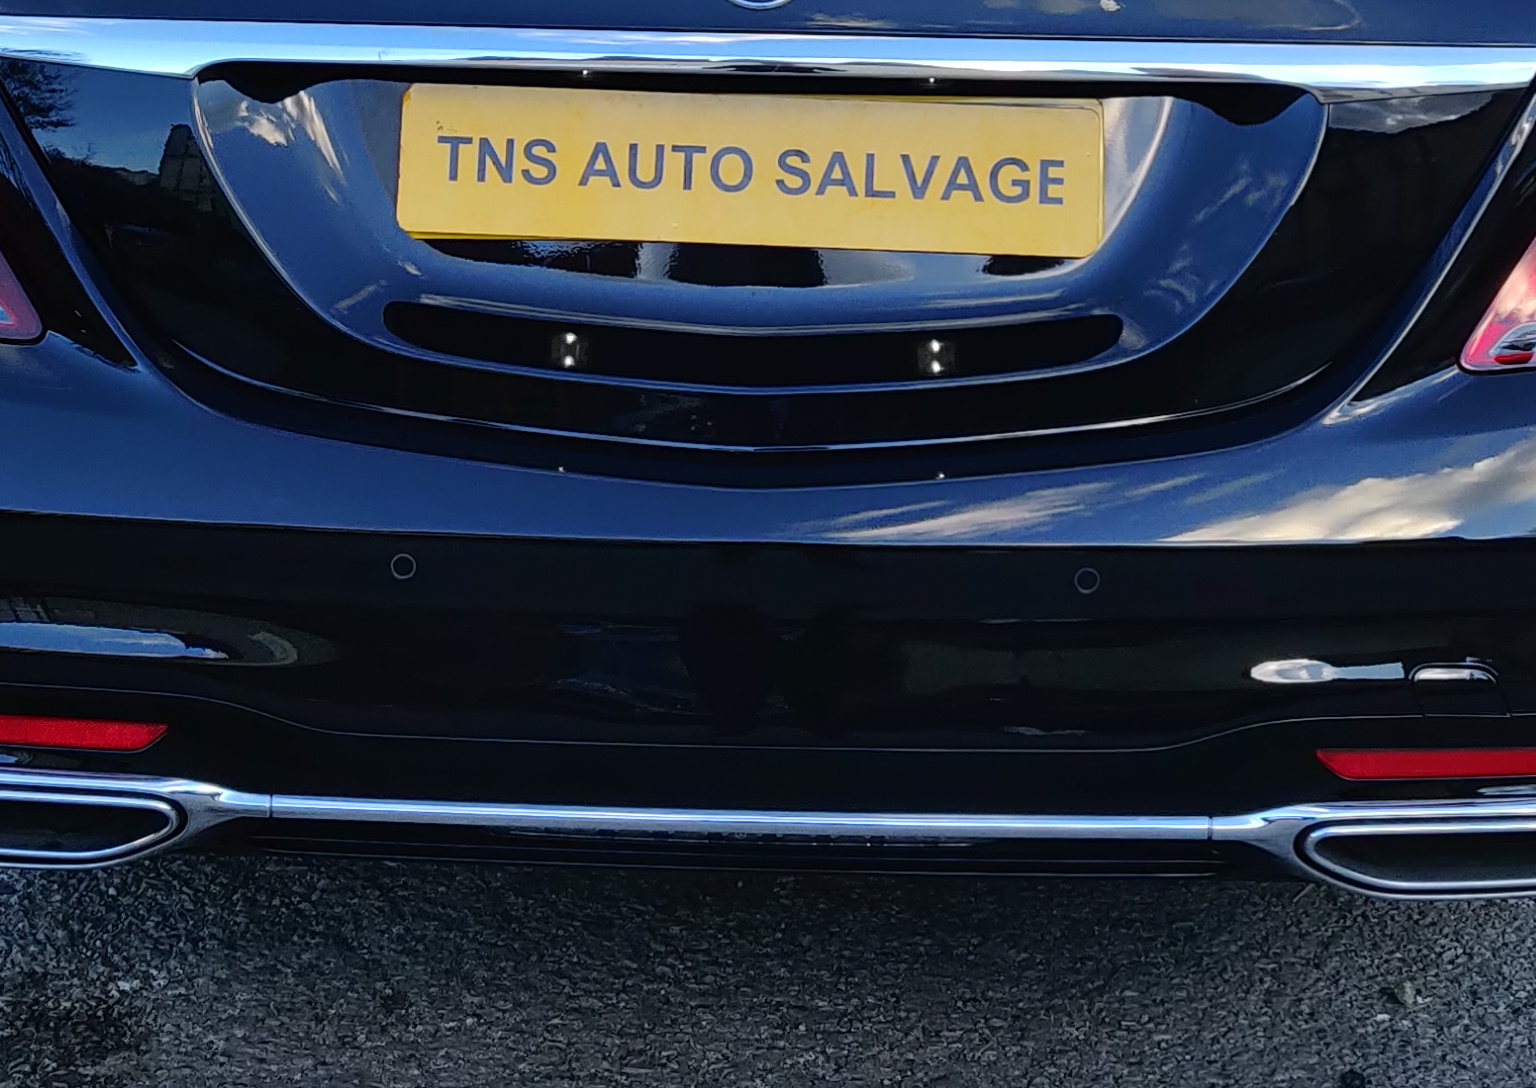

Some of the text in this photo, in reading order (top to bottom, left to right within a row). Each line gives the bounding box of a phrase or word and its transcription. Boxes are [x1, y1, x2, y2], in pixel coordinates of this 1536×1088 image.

[437, 135, 1065, 205] TNS AUTO SALVAGE
